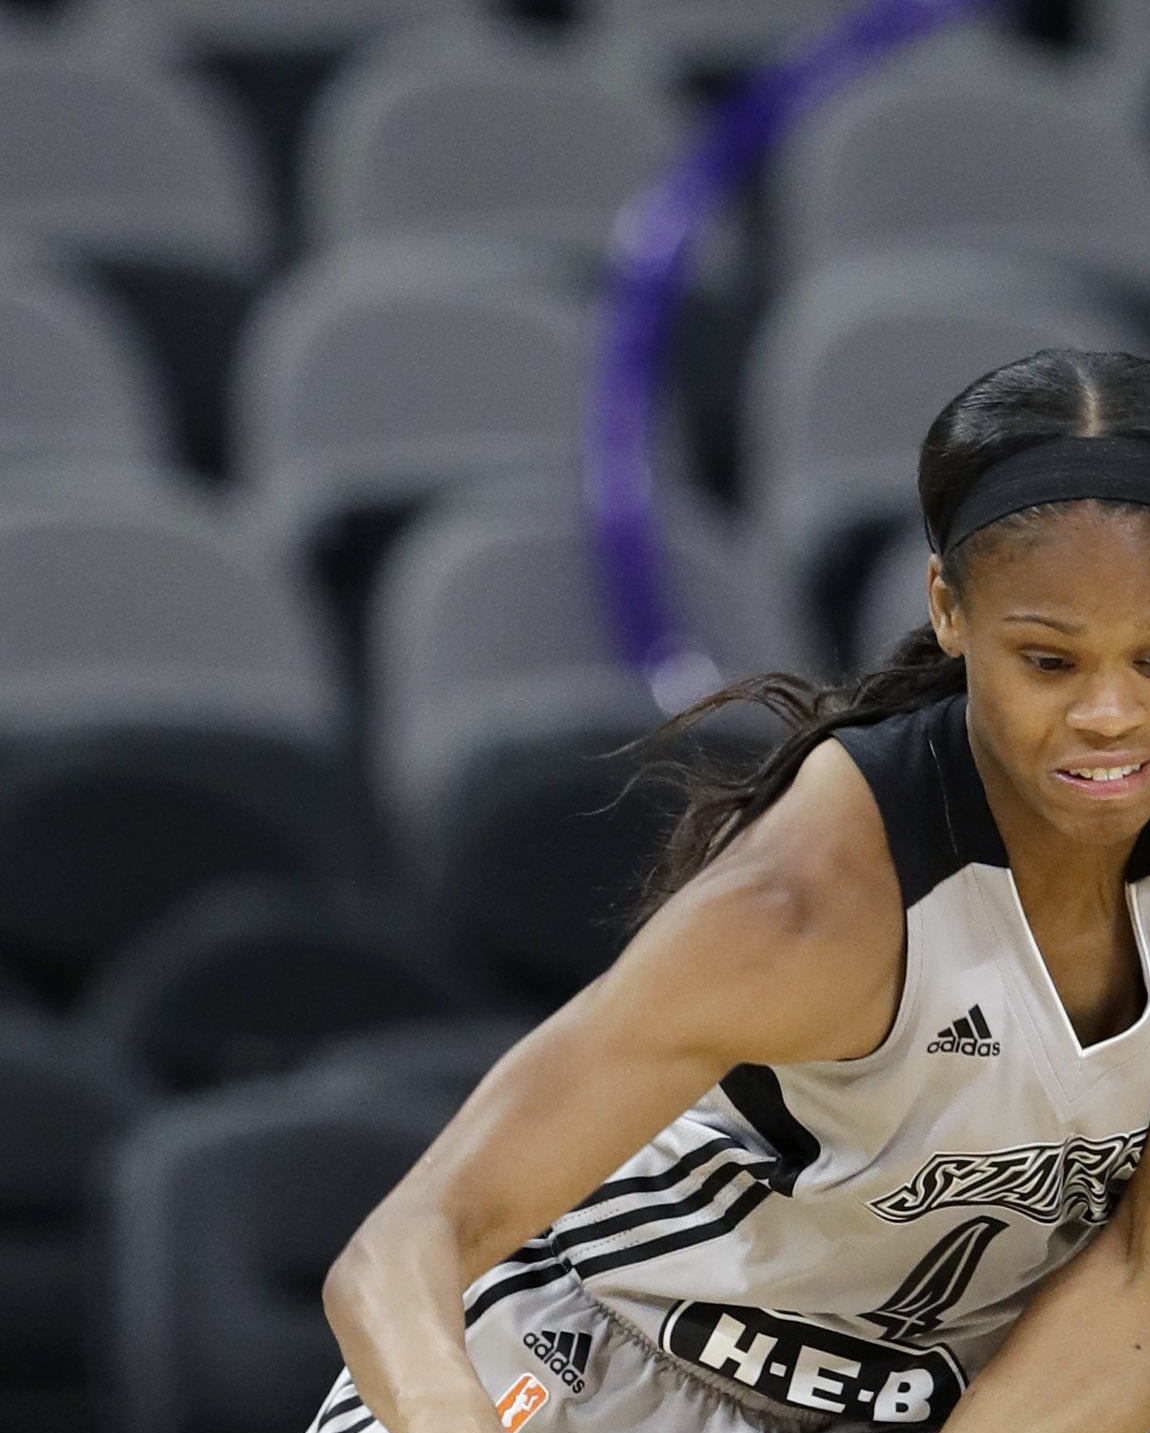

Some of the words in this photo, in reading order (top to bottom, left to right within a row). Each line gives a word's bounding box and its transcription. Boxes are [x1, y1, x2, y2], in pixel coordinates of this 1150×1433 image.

[926, 1036, 1001, 1058] adidas
[864, 1128, 1150, 1225] STAR
[857, 1214, 1011, 1340] 4
[522, 1332, 586, 1394] adidas
